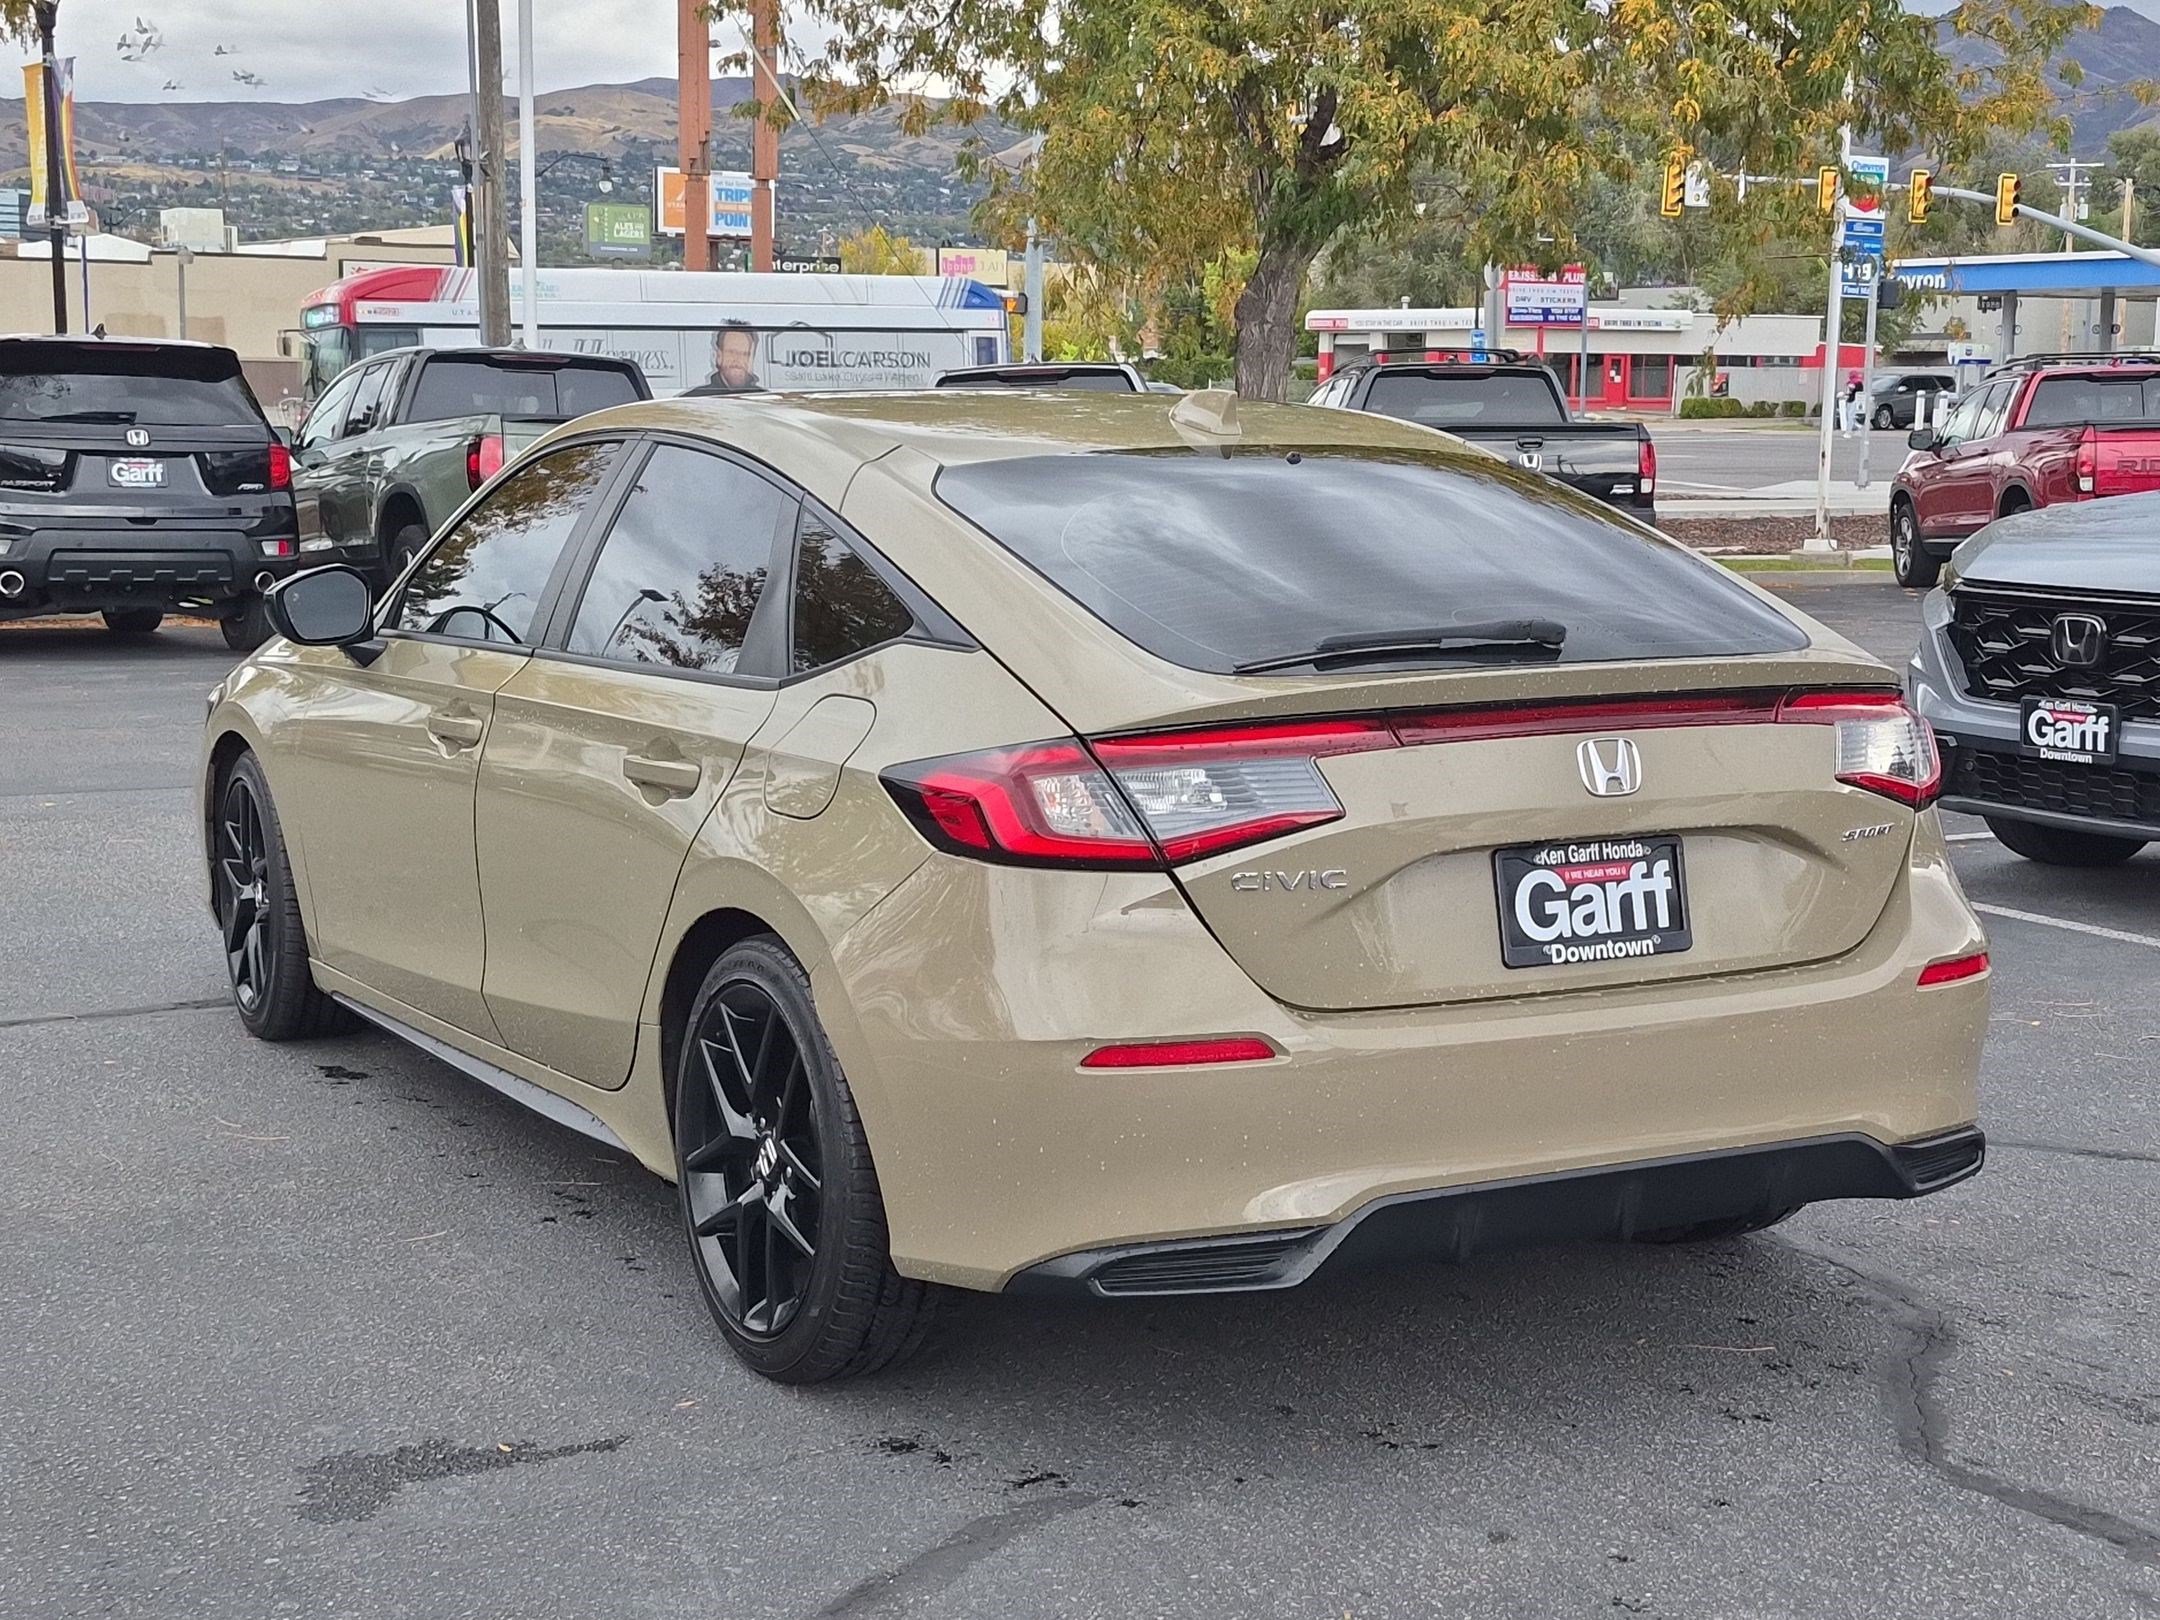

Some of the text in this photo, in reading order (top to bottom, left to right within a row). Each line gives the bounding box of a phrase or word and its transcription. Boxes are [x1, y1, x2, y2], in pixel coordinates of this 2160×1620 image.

[111, 462, 163, 482] Garff
[2028, 709, 2109, 752] Garff
[2040, 747, 2093, 764] Downtown
[1841, 822, 1895, 842] SPORT
[1541, 840, 1643, 866] Ken Garff Honda
[1571, 867, 1621, 880] WE HEAR YOU
[1515, 859, 1672, 942] Garff
[1551, 938, 1655, 964] Downtown
